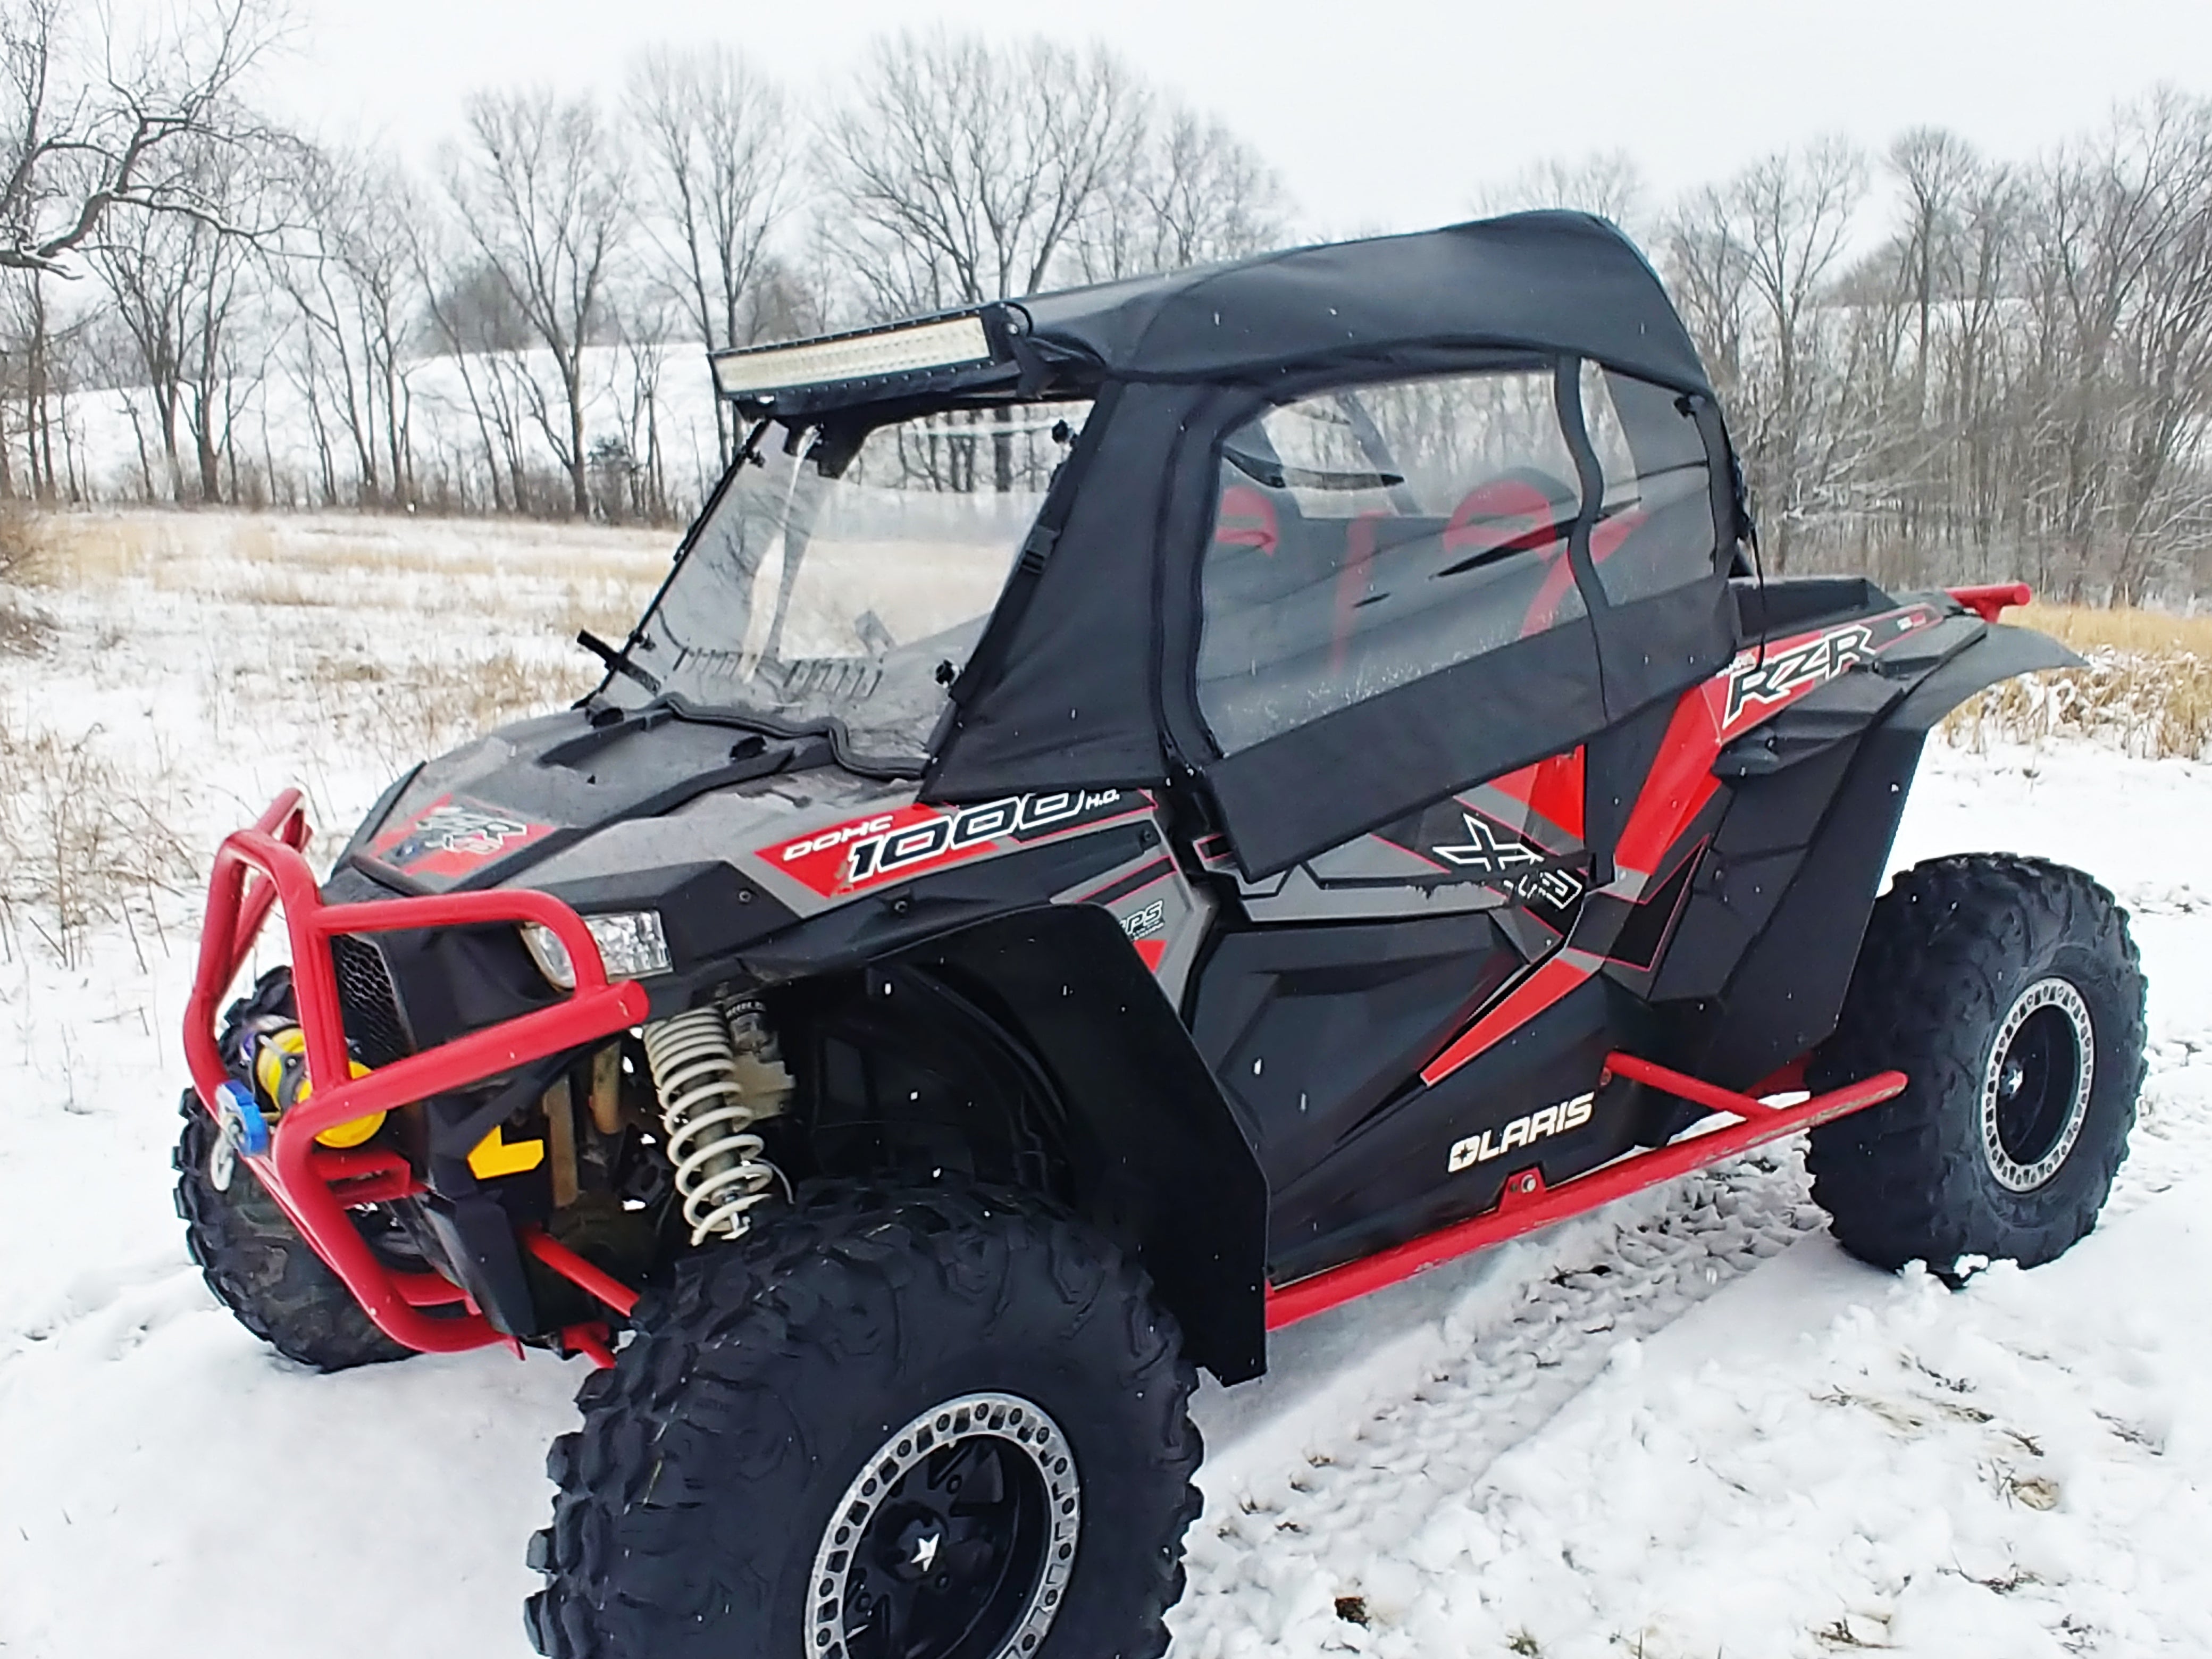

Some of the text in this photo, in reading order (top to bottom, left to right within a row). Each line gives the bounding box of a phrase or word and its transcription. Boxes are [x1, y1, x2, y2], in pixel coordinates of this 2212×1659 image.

[1723, 624, 1876, 729] RZR
[783, 816, 893, 861] DOHC
[848, 790, 1085, 883] 1000
